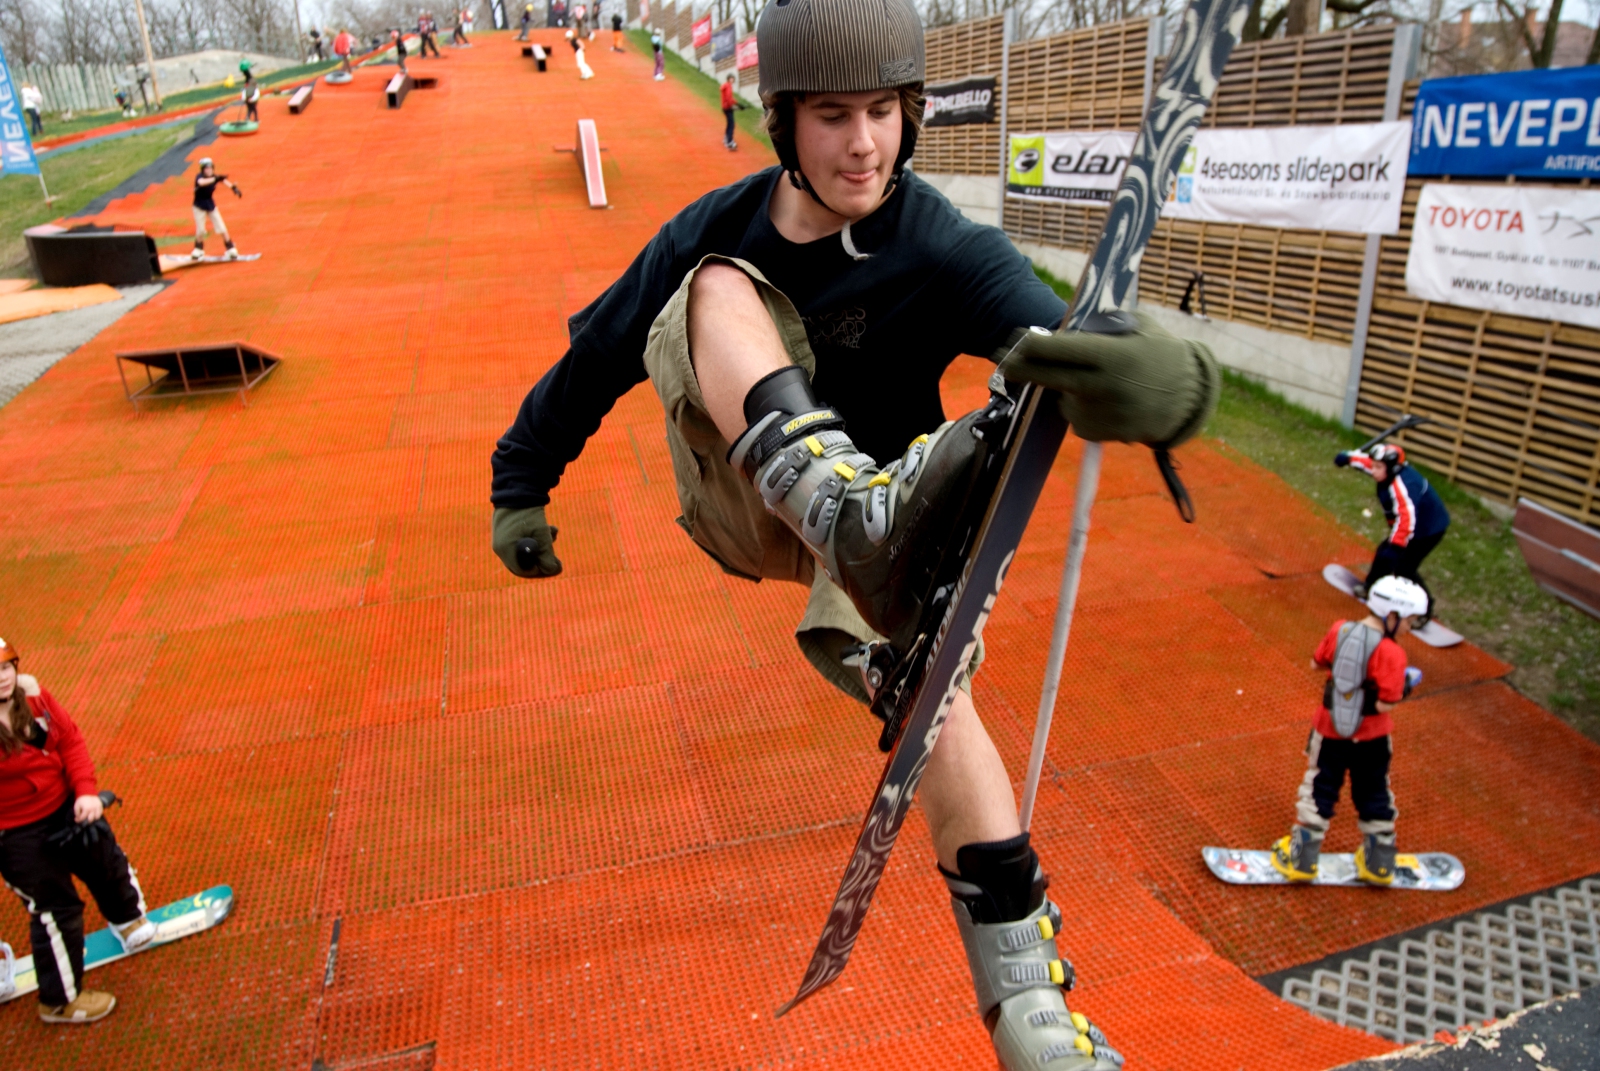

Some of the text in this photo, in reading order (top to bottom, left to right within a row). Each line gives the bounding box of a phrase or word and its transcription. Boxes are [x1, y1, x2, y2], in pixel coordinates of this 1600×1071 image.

[1201, 154, 1390, 188] 4seasons slidepark
[1429, 205, 1524, 233] TOYOTA
[785, 411, 833, 433] NORDICA
[925, 556, 972, 675] ATOMIC
